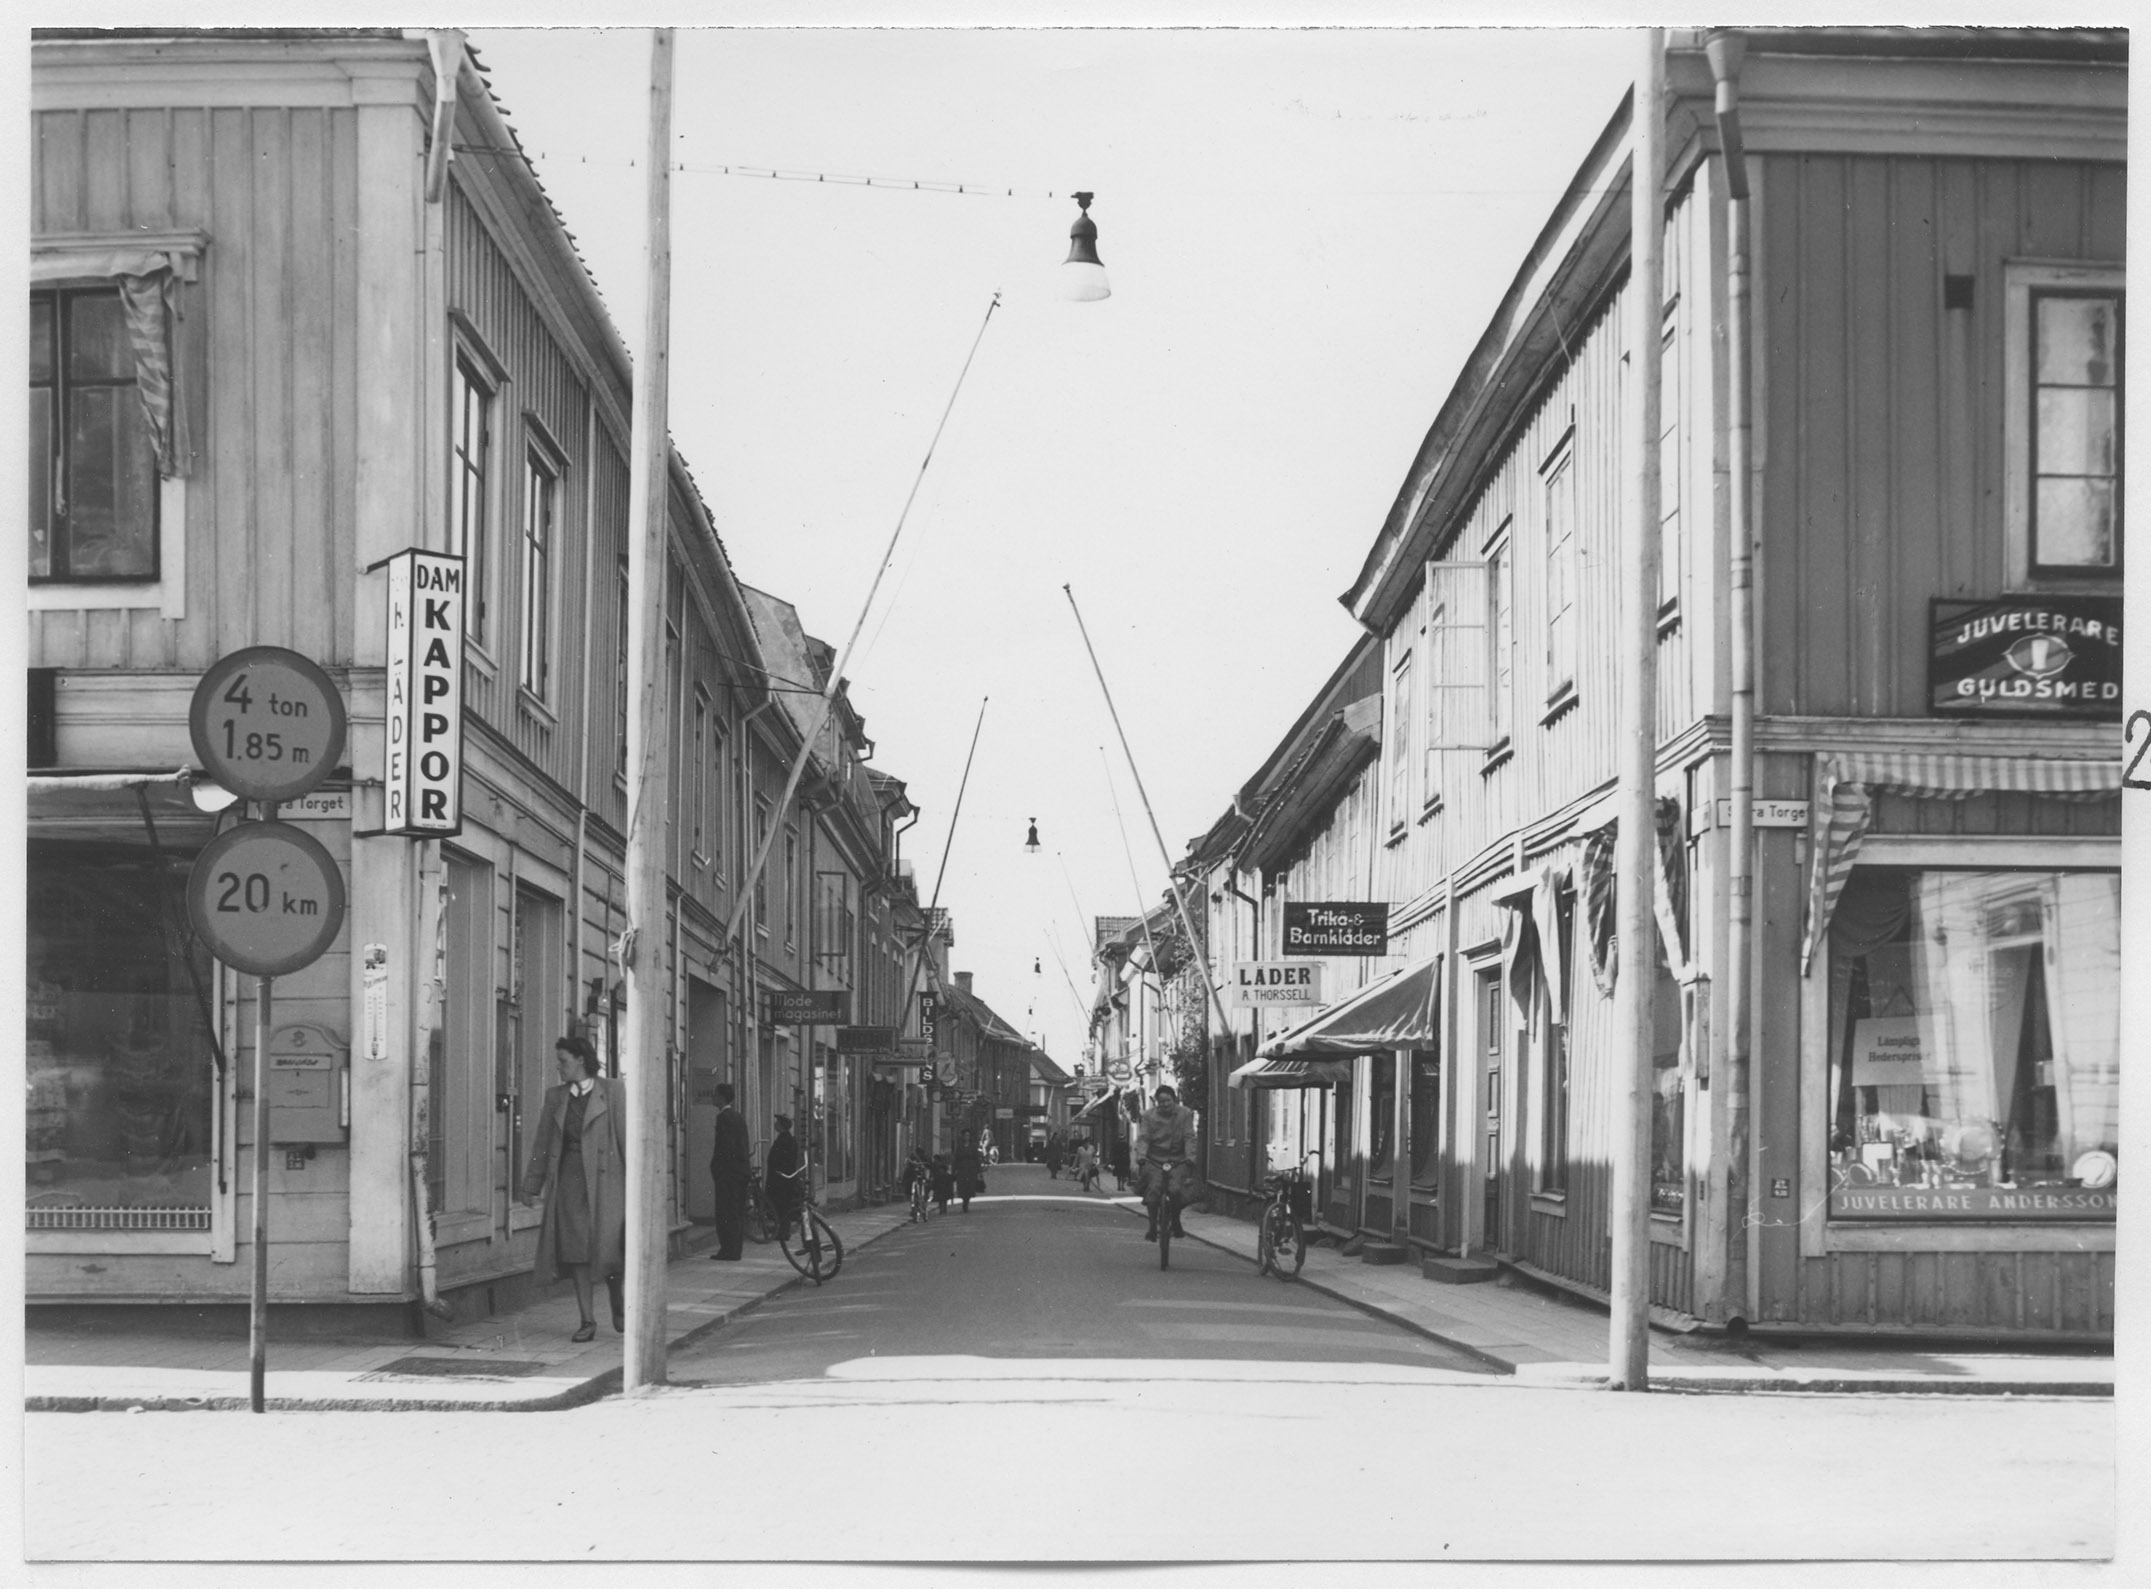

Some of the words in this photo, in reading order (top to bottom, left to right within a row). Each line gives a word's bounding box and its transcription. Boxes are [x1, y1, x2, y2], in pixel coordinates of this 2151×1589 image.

[417, 563, 460, 594] DAM
[1957, 612, 2119, 646] JUVELERARE
[223, 673, 253, 714] 4
[268, 692, 308, 718] ton
[1957, 677, 2119, 699] GULDSMED
[420, 597, 451, 820] KAPPOR
[223, 718, 283, 761] 1.85
[292, 746, 309, 763] m
[1769, 804, 1808, 822] Torge
[217, 871, 270, 913] 20
[282, 891, 318, 916] km
[1240, 966, 1311, 985] LÄDER
[774, 993, 812, 1007] Mode
[1254, 988, 1311, 1001] THORSSELL
[774, 1008, 841, 1023] magasinet
[1841, 1194, 1972, 1211] JUVELERARE
